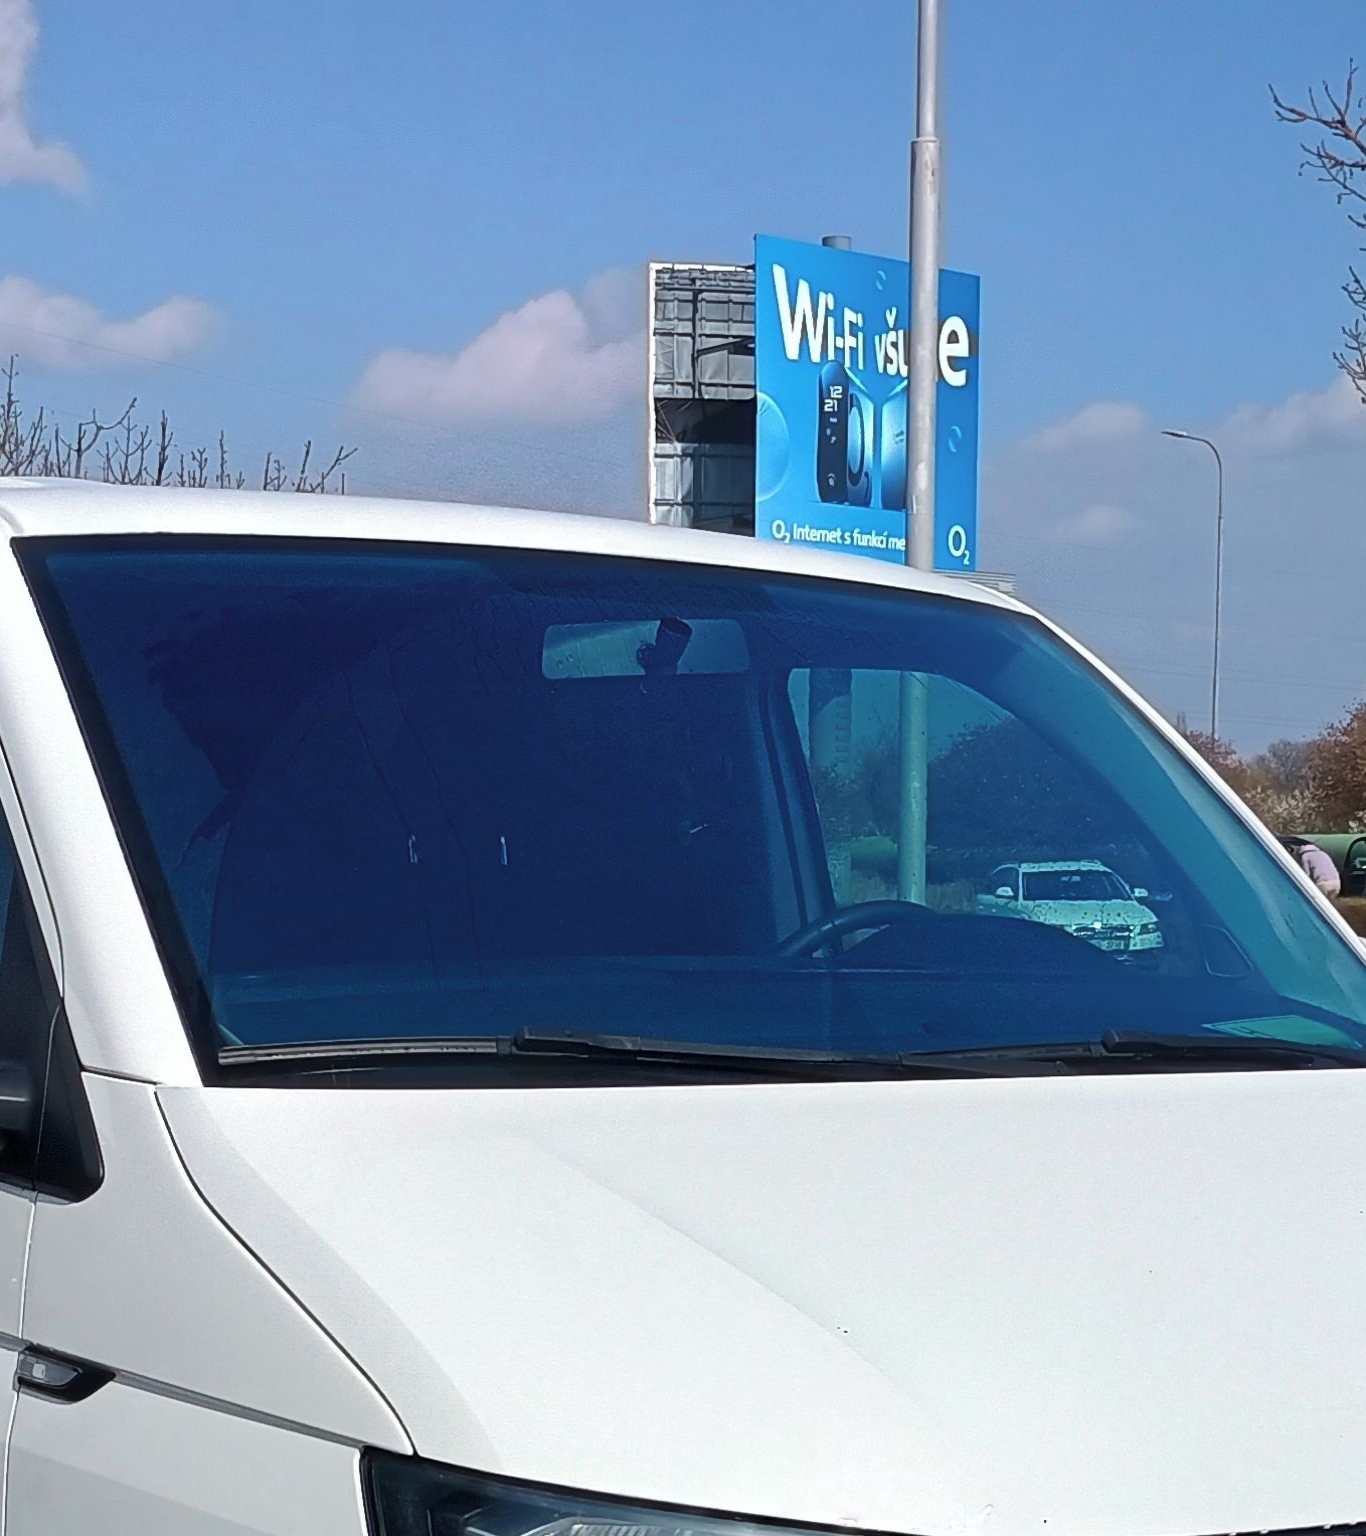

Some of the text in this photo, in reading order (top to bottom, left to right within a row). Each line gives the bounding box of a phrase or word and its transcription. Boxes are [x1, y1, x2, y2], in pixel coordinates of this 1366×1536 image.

[772, 263, 969, 387] Wi-Fi všue
[829, 385, 843, 398] 12
[823, 399, 838, 412] 21
[793, 523, 841, 544] Internet
[844, 531, 851, 545] s
[852, 528, 889, 549] funkcí
[888, 537, 906, 551] me
